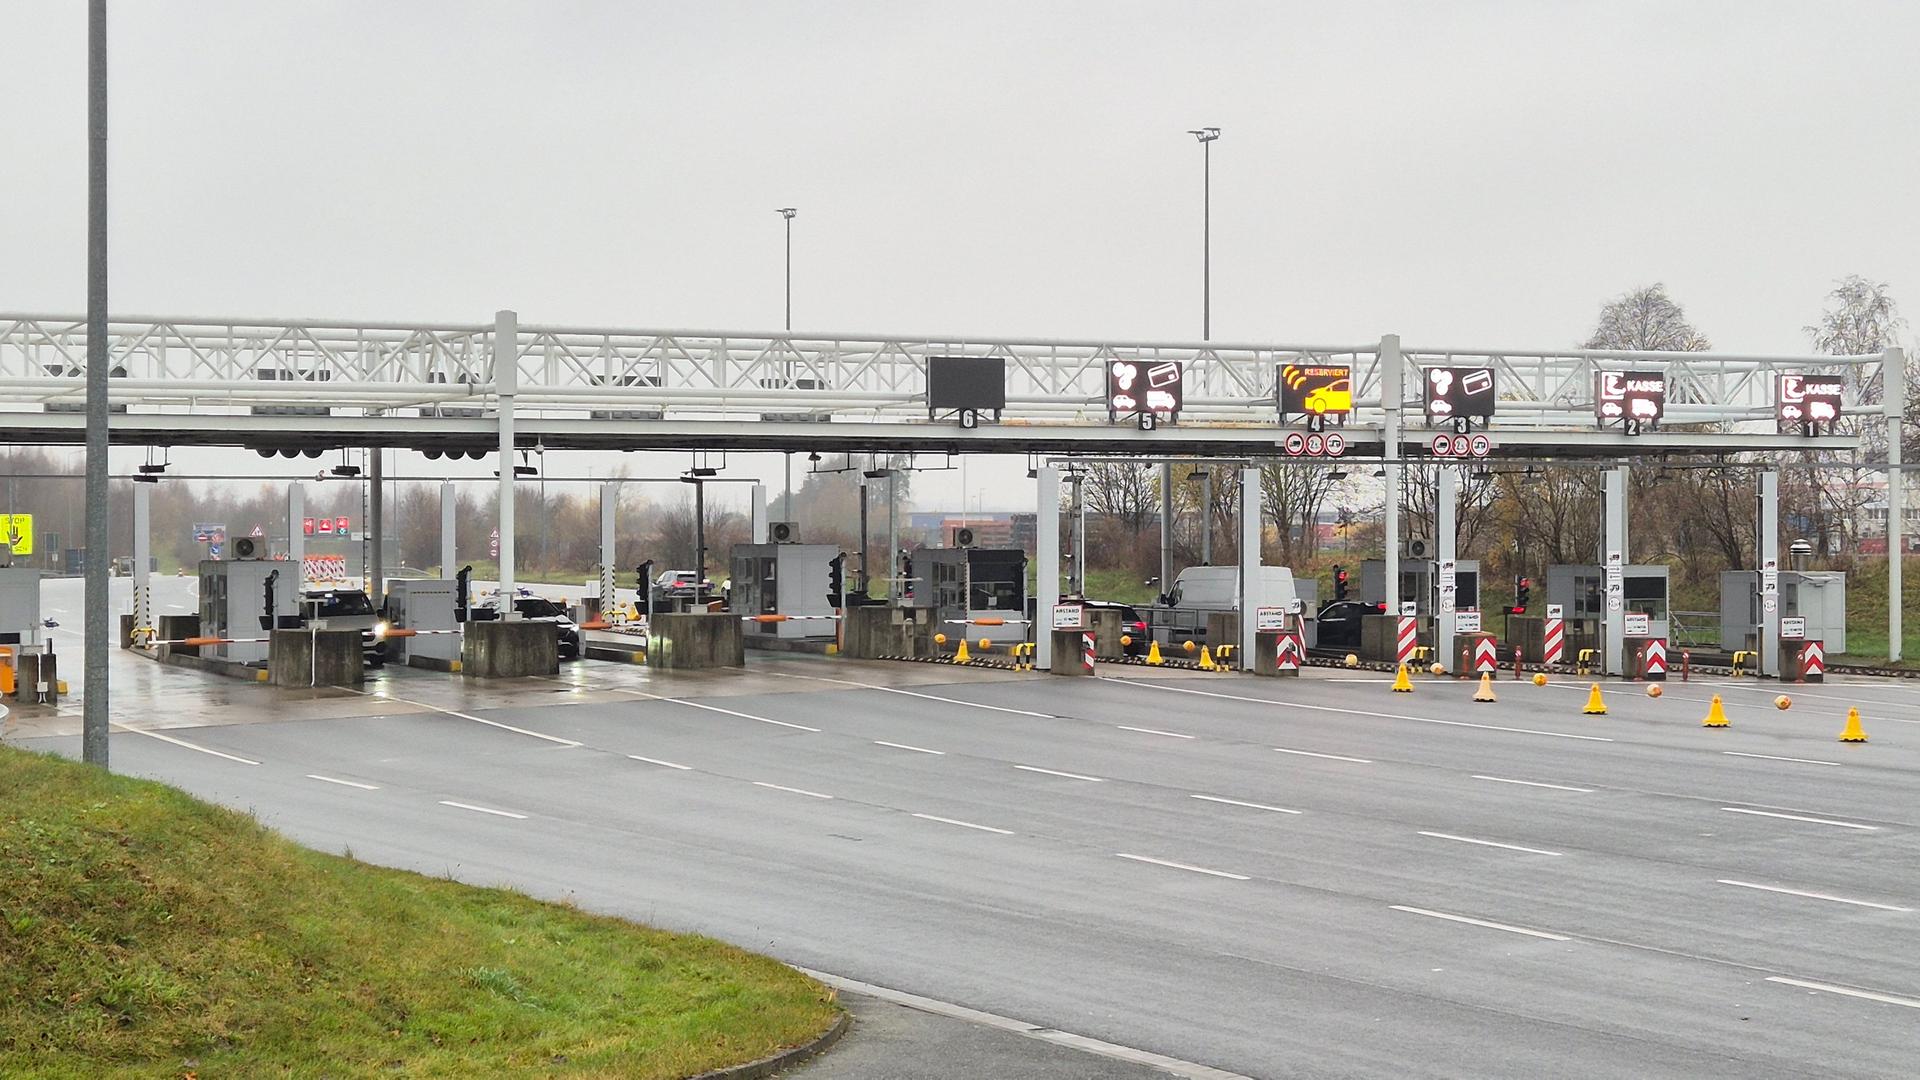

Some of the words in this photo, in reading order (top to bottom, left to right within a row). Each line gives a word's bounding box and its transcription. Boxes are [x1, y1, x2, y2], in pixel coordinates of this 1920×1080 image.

[1627, 380, 1663, 392] KASSE
[1806, 384, 1841, 396] KASSE
[963, 410, 974, 427] 6
[1143, 412, 1152, 430] 5
[1311, 415, 1321, 432] 4
[1457, 416, 1467, 433] 3
[1628, 419, 1637, 435] 2
[1807, 421, 1814, 436] 1
